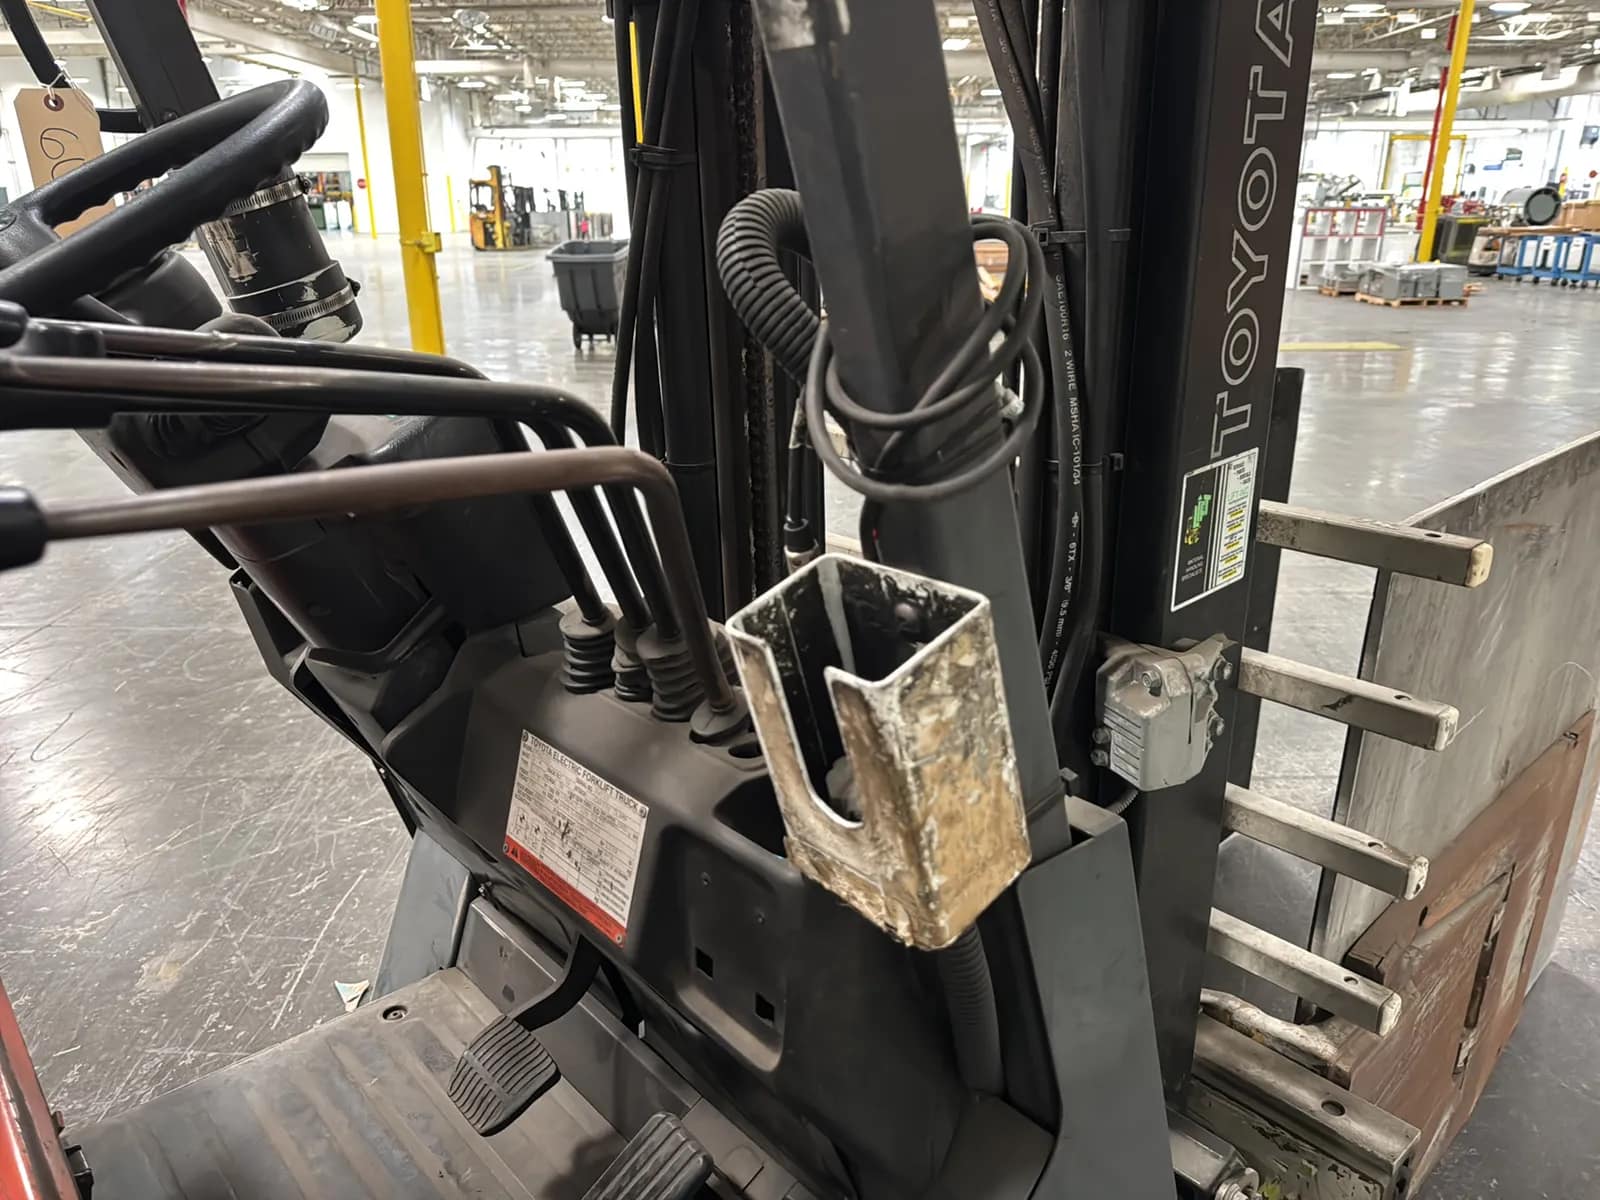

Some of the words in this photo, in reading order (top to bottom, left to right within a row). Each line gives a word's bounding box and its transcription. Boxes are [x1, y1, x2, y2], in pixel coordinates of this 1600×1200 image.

[1211, 0, 1297, 459] TOYOTA
[1065, 359, 1078, 392] WIRE
[1069, 396, 1081, 432] MSHA
